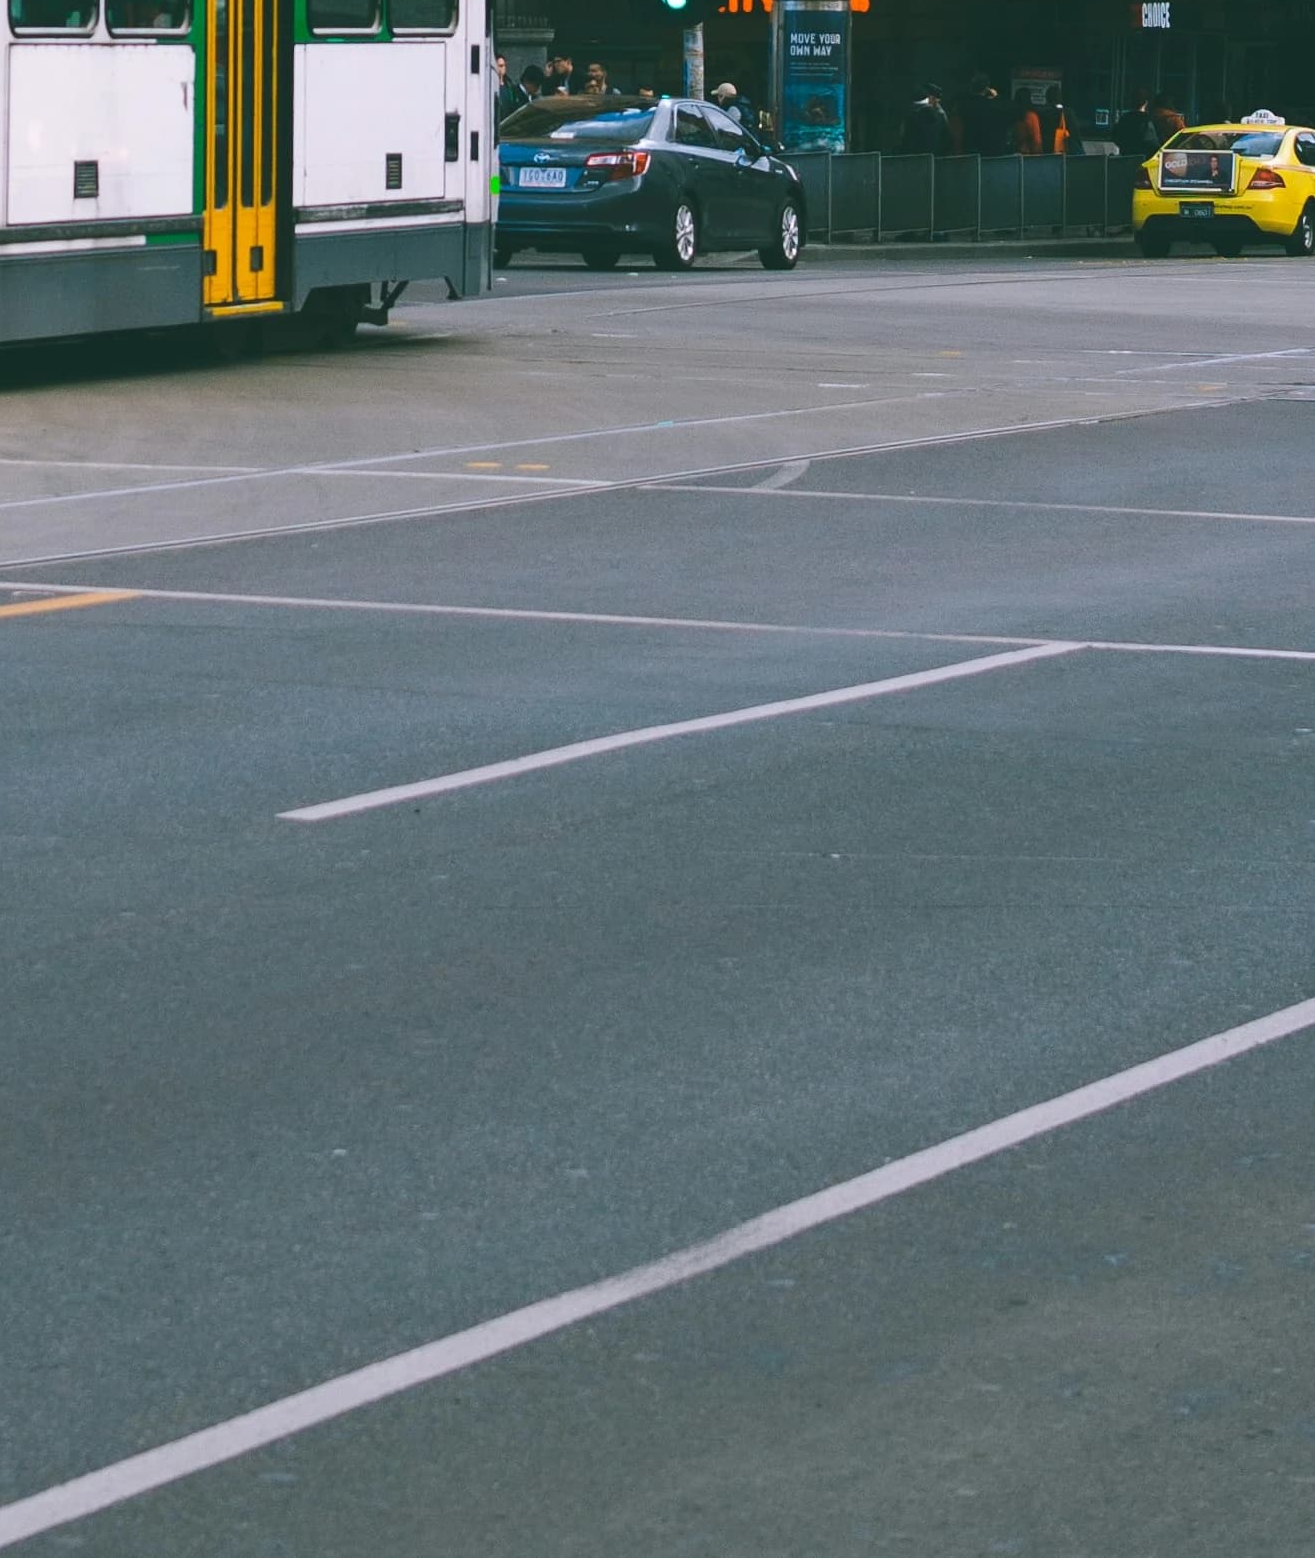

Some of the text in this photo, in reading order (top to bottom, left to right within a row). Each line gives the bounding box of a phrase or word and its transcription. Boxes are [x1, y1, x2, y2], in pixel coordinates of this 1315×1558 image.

[1142, 2, 1170, 28] CHOICE
[790, 34, 841, 44] MOVE YOUR
[790, 46, 832, 56] OWN WAY
